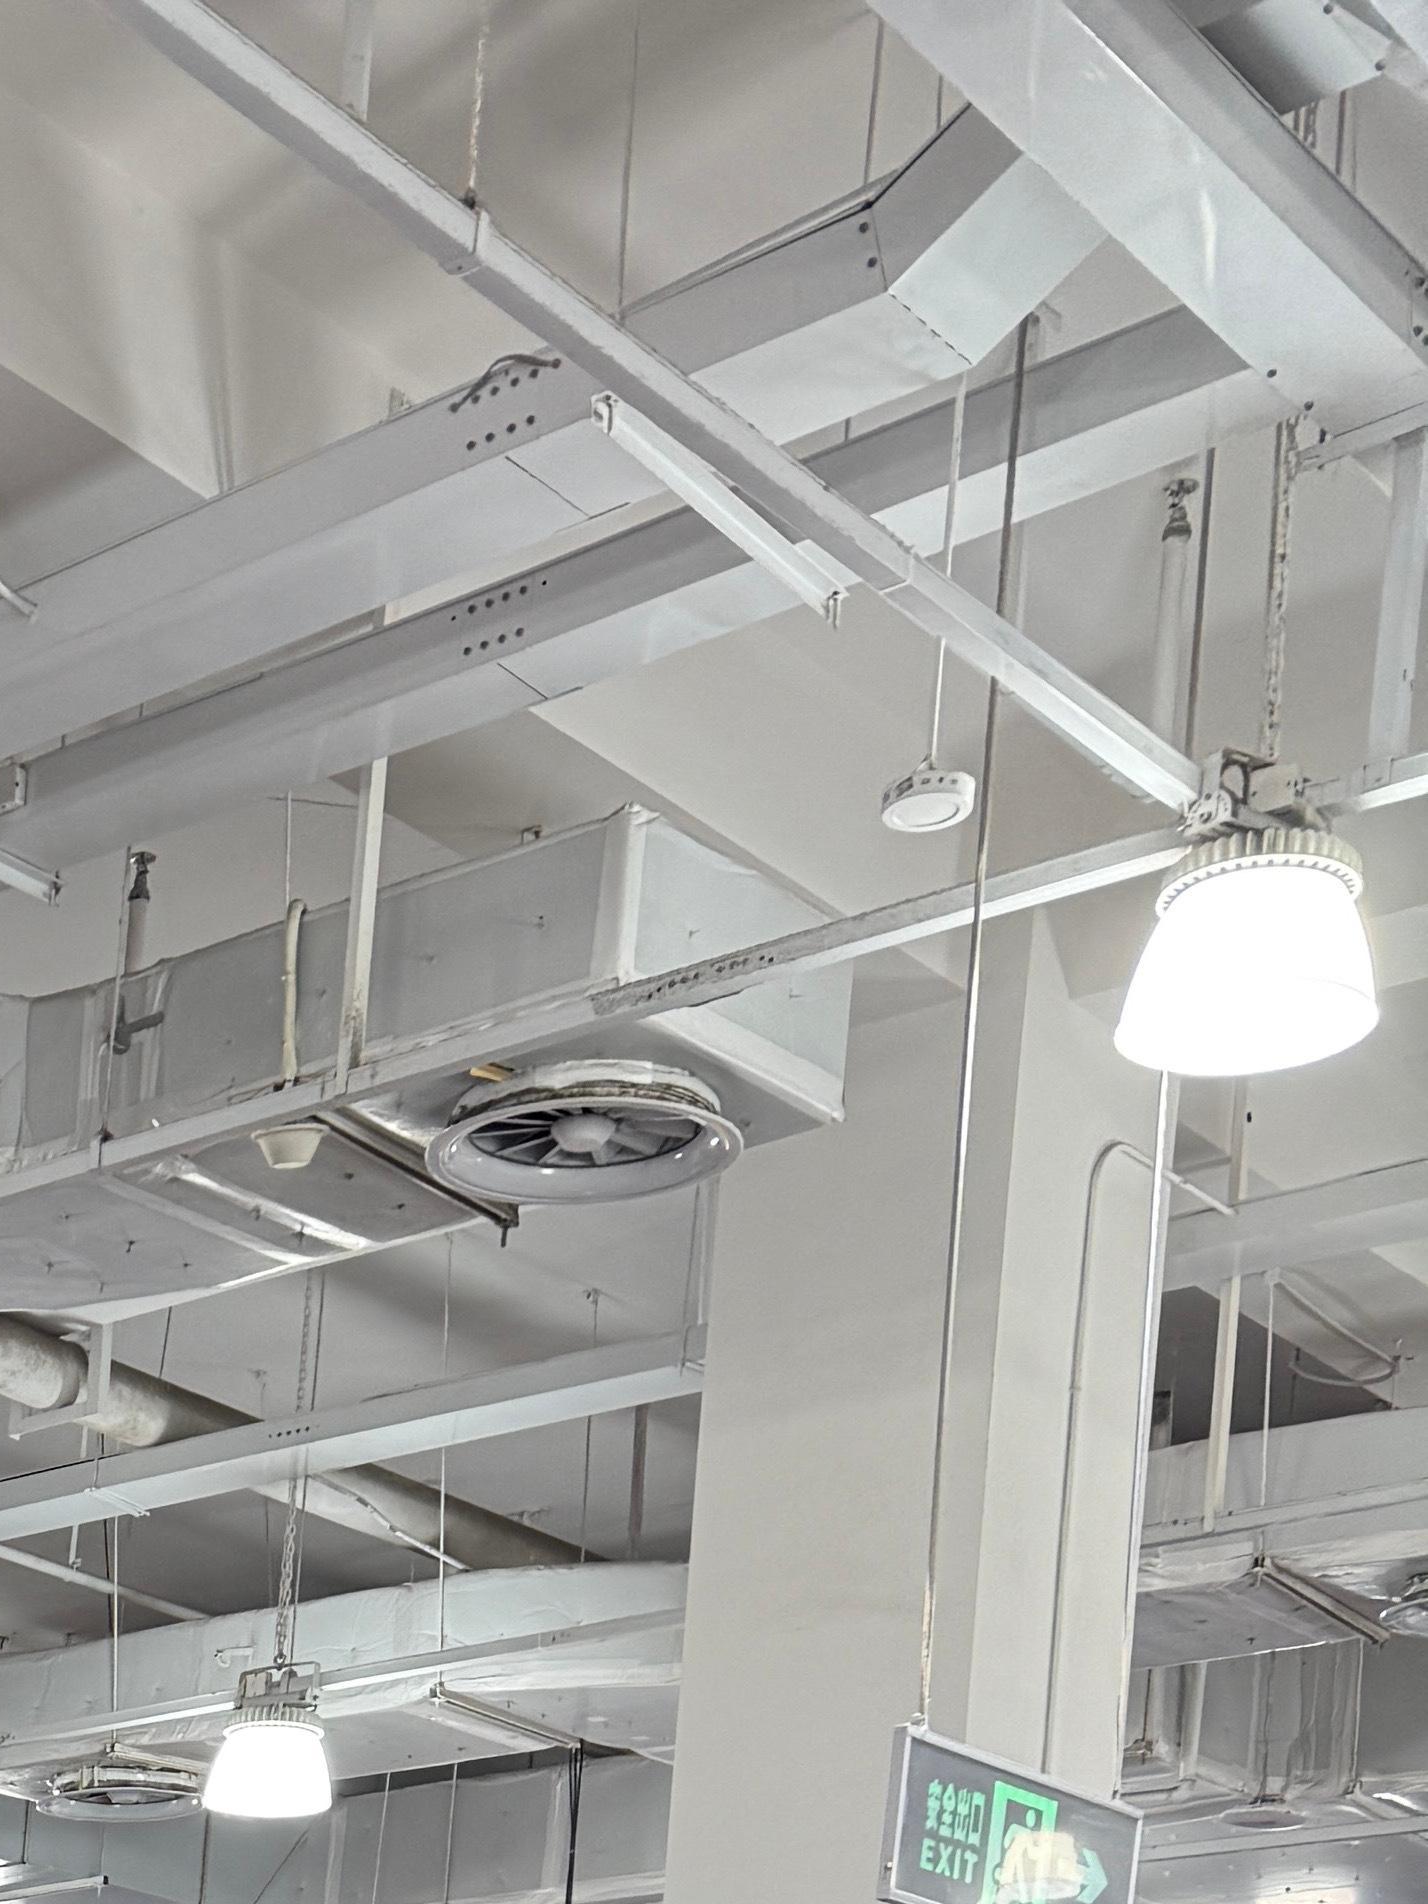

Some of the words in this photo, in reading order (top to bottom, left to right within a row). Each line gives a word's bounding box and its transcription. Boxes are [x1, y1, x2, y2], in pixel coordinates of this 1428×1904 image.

[925, 1778, 986, 1848] 安全出口
[919, 1837, 979, 1884] EXIT
